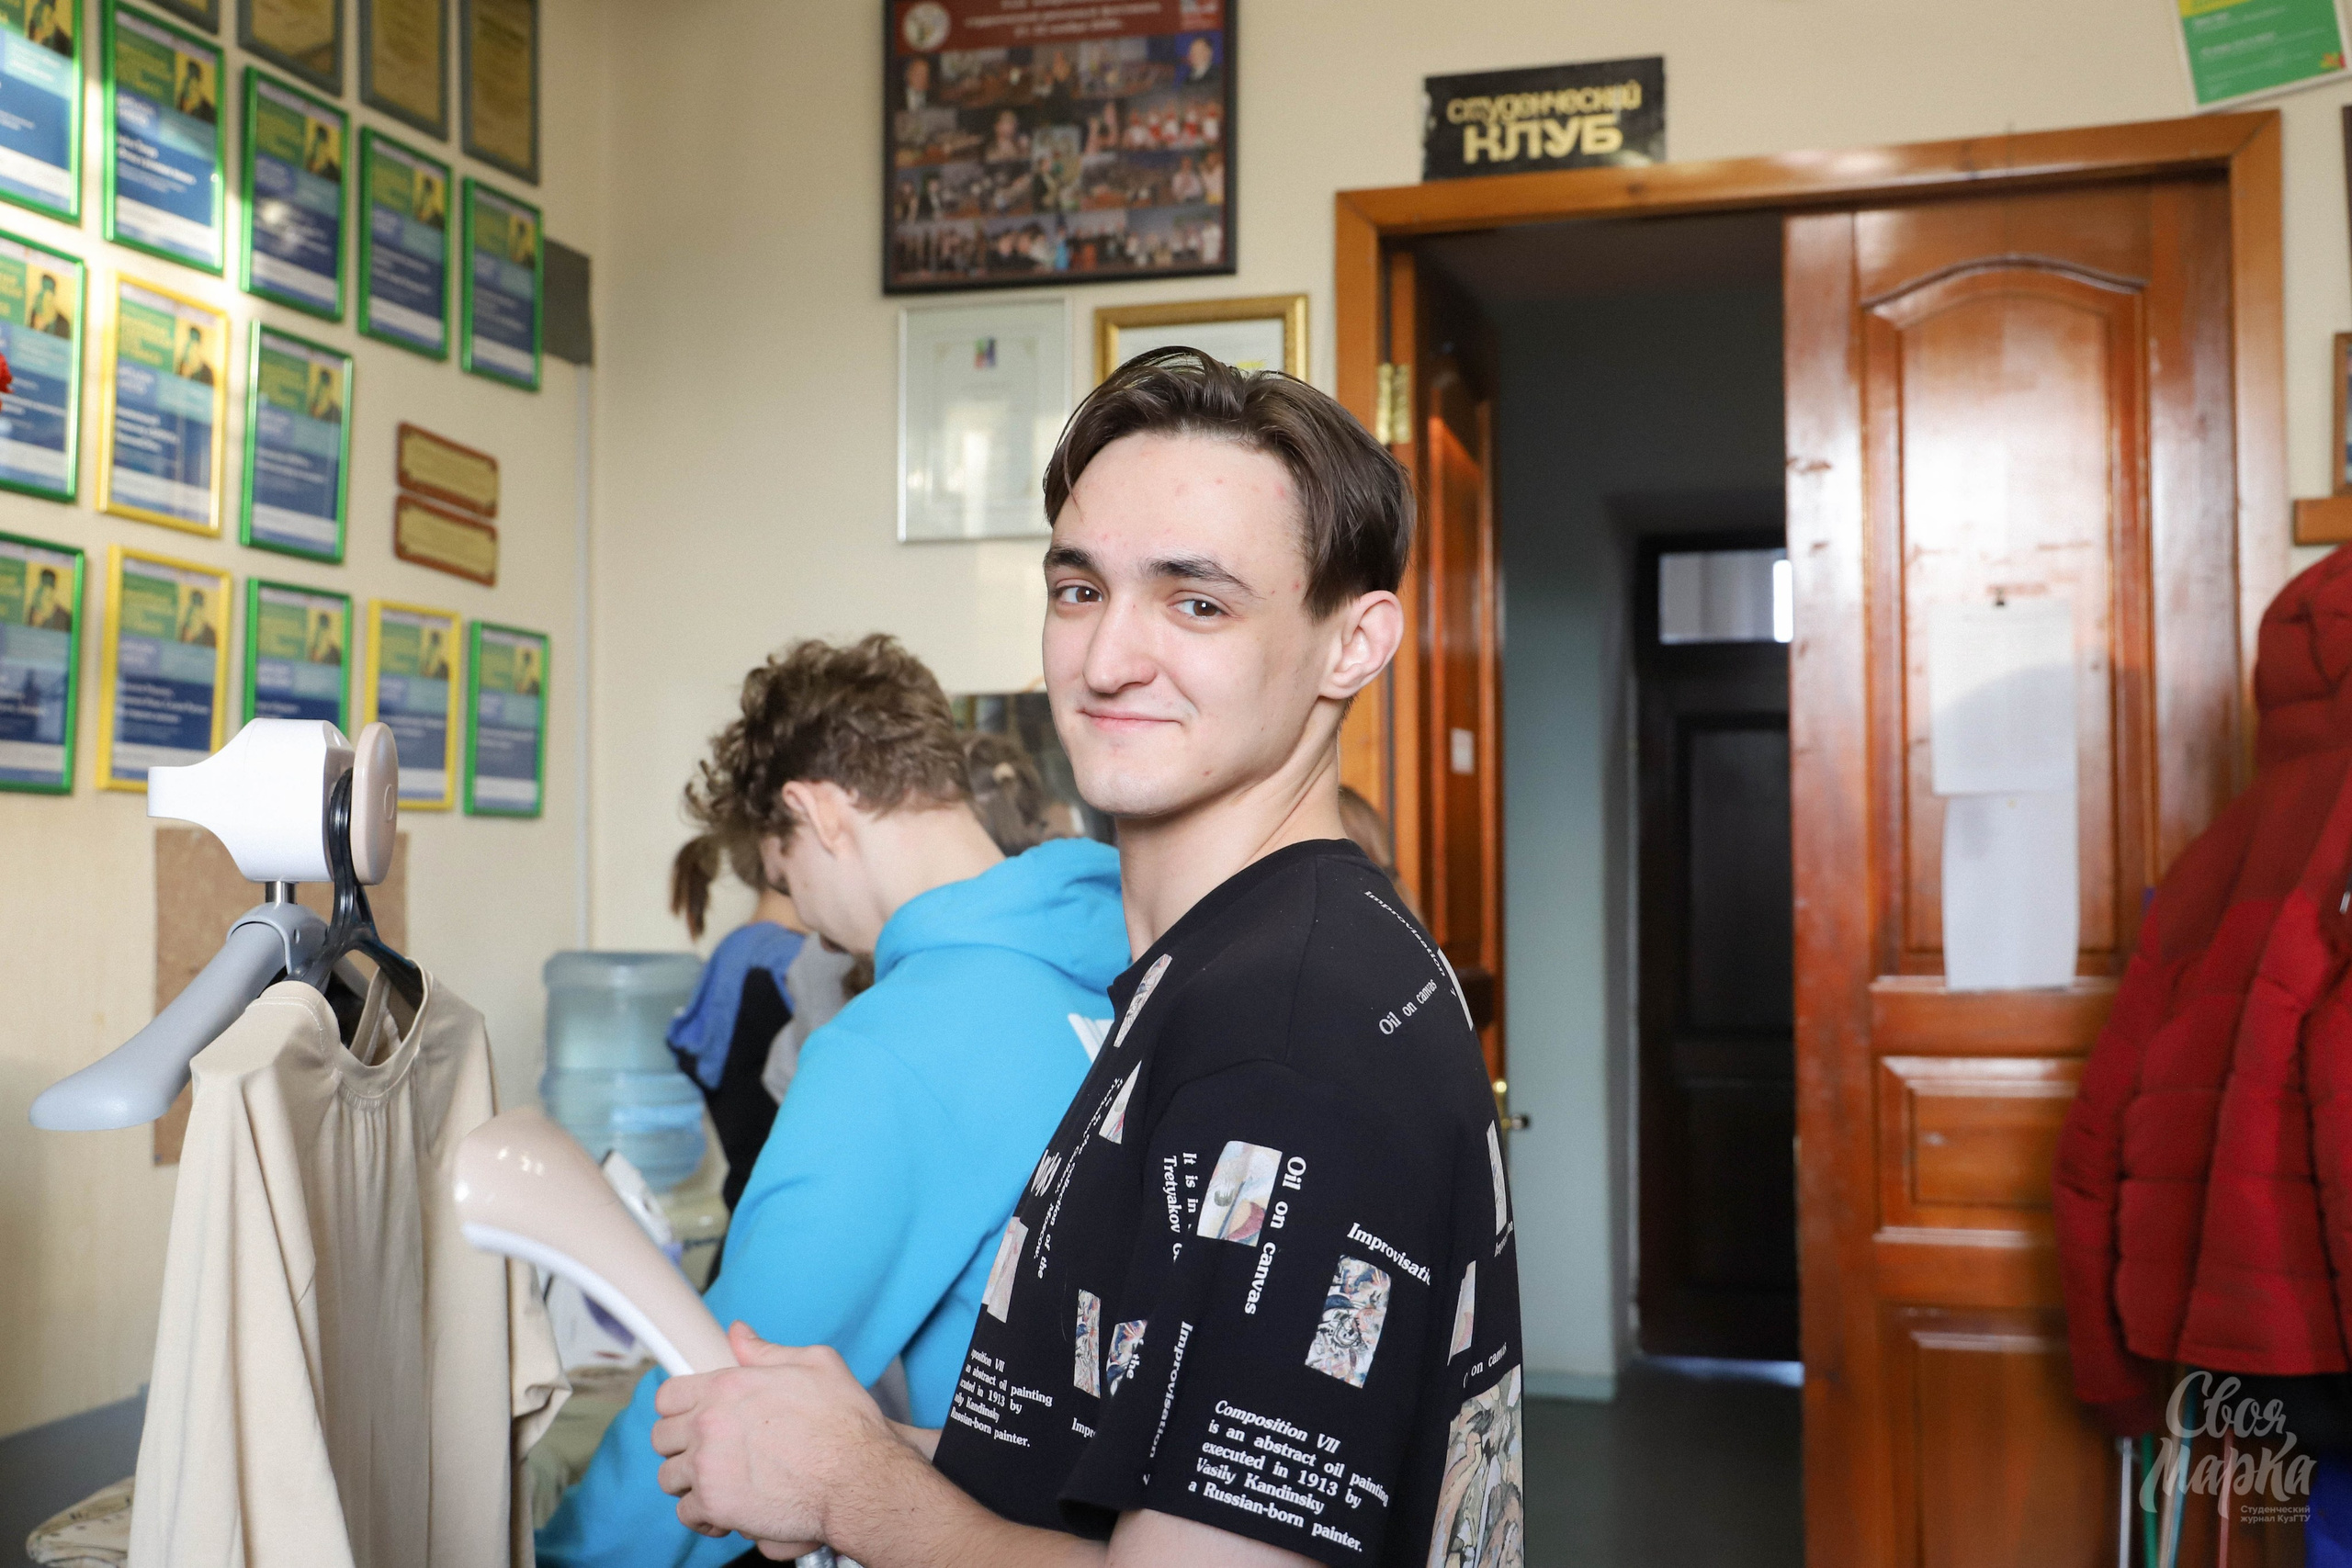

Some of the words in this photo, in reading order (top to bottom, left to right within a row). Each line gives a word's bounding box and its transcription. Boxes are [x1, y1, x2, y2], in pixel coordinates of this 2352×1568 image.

[1364, 890, 1446, 976] Improvisation
[1378, 1010, 1402, 1035] Oil
[1402, 1001, 1418, 1017] on
[1416, 979, 1438, 1005] canvas
[1182, 1152, 1198, 1165] It
[1282, 1156, 1306, 1190] Oil
[1050, 1162, 1076, 1226] collection
[1162, 1155, 1183, 1234] Tretyakov
[1184, 1175, 1199, 1189] is
[1187, 1198, 1199, 1213] in
[1270, 1201, 1289, 1229] on
[1045, 1234, 1052, 1251] of
[1037, 1256, 1047, 1279] the
[1244, 1241, 1276, 1315] canvas
[995, 1358, 1005, 1372] VII
[1471, 1361, 1484, 1377] on
[972, 1366, 996, 1386] abstract
[999, 1380, 1008, 1392] oil
[1011, 1384, 1053, 1407] painting
[977, 1385, 984, 1397] in
[988, 1390, 1006, 1407] 1913
[1010, 1398, 1023, 1415] by
[1149, 1320, 1193, 1458] Improvisation
[950, 1406, 991, 1435] Russian-born
[993, 1428, 1031, 1447] painter.
[966, 1396, 1000, 1424] Kandinsky
[1215, 1399, 1309, 1442] Composition
[1316, 1433, 1341, 1454] VII
[1202, 1440, 1266, 1470] executed
[1272, 1461, 1289, 1479] in
[1297, 1470, 1339, 1496] 1913
[1345, 1488, 1363, 1509] by
[1207, 1419, 1220, 1434] is
[1226, 1427, 1246, 1442] an
[1253, 1435, 1317, 1467] abstract
[1323, 1461, 1346, 1478] oil
[1350, 1472, 1389, 1507] painting
[1196, 1457, 1238, 1485] Vasily
[1244, 1472, 1326, 1516] Kandinsky
[1188, 1480, 1198, 1493] a
[1203, 1481, 1306, 1528] Russian-born
[1311, 1521, 1363, 1552] painter.
